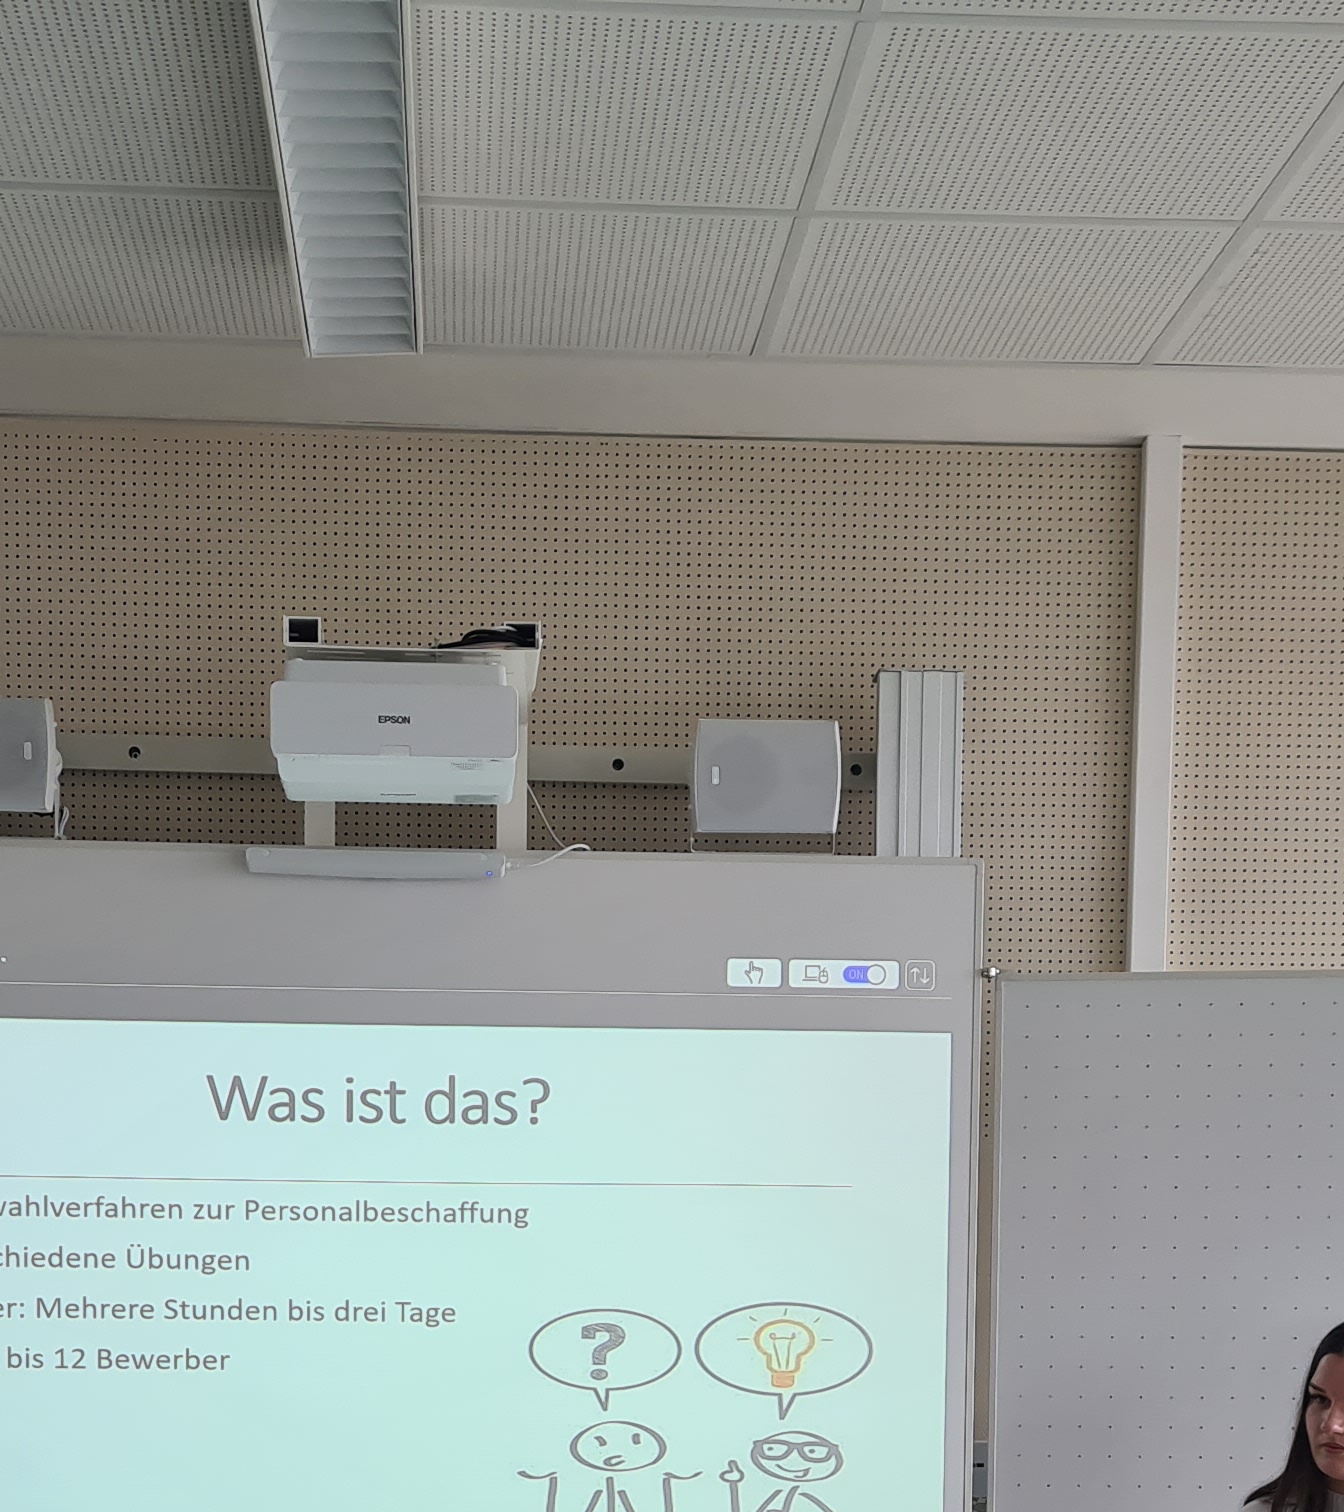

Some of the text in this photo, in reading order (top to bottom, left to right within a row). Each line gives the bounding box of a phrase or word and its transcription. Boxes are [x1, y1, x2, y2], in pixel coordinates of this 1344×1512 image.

[378, 715, 411, 724] EPSON
[848, 968, 864, 980] ON
[205, 1074, 551, 1126] Was ist das?
[192, 1203, 236, 1221] zur
[245, 1199, 530, 1229] Personalbeschaffung
[126, 1243, 250, 1276] Übungen
[36, 1295, 155, 1320] Mehrere
[163, 1297, 278, 1322] Stunden
[288, 1298, 325, 1322] bis
[334, 1299, 386, 1323] drei
[394, 1301, 456, 1328] Tage
[7, 1345, 44, 1369] bis
[54, 1347, 87, 1370] 12
[97, 1347, 231, 1371] Bewerber
[581, 1322, 626, 1381] ?
